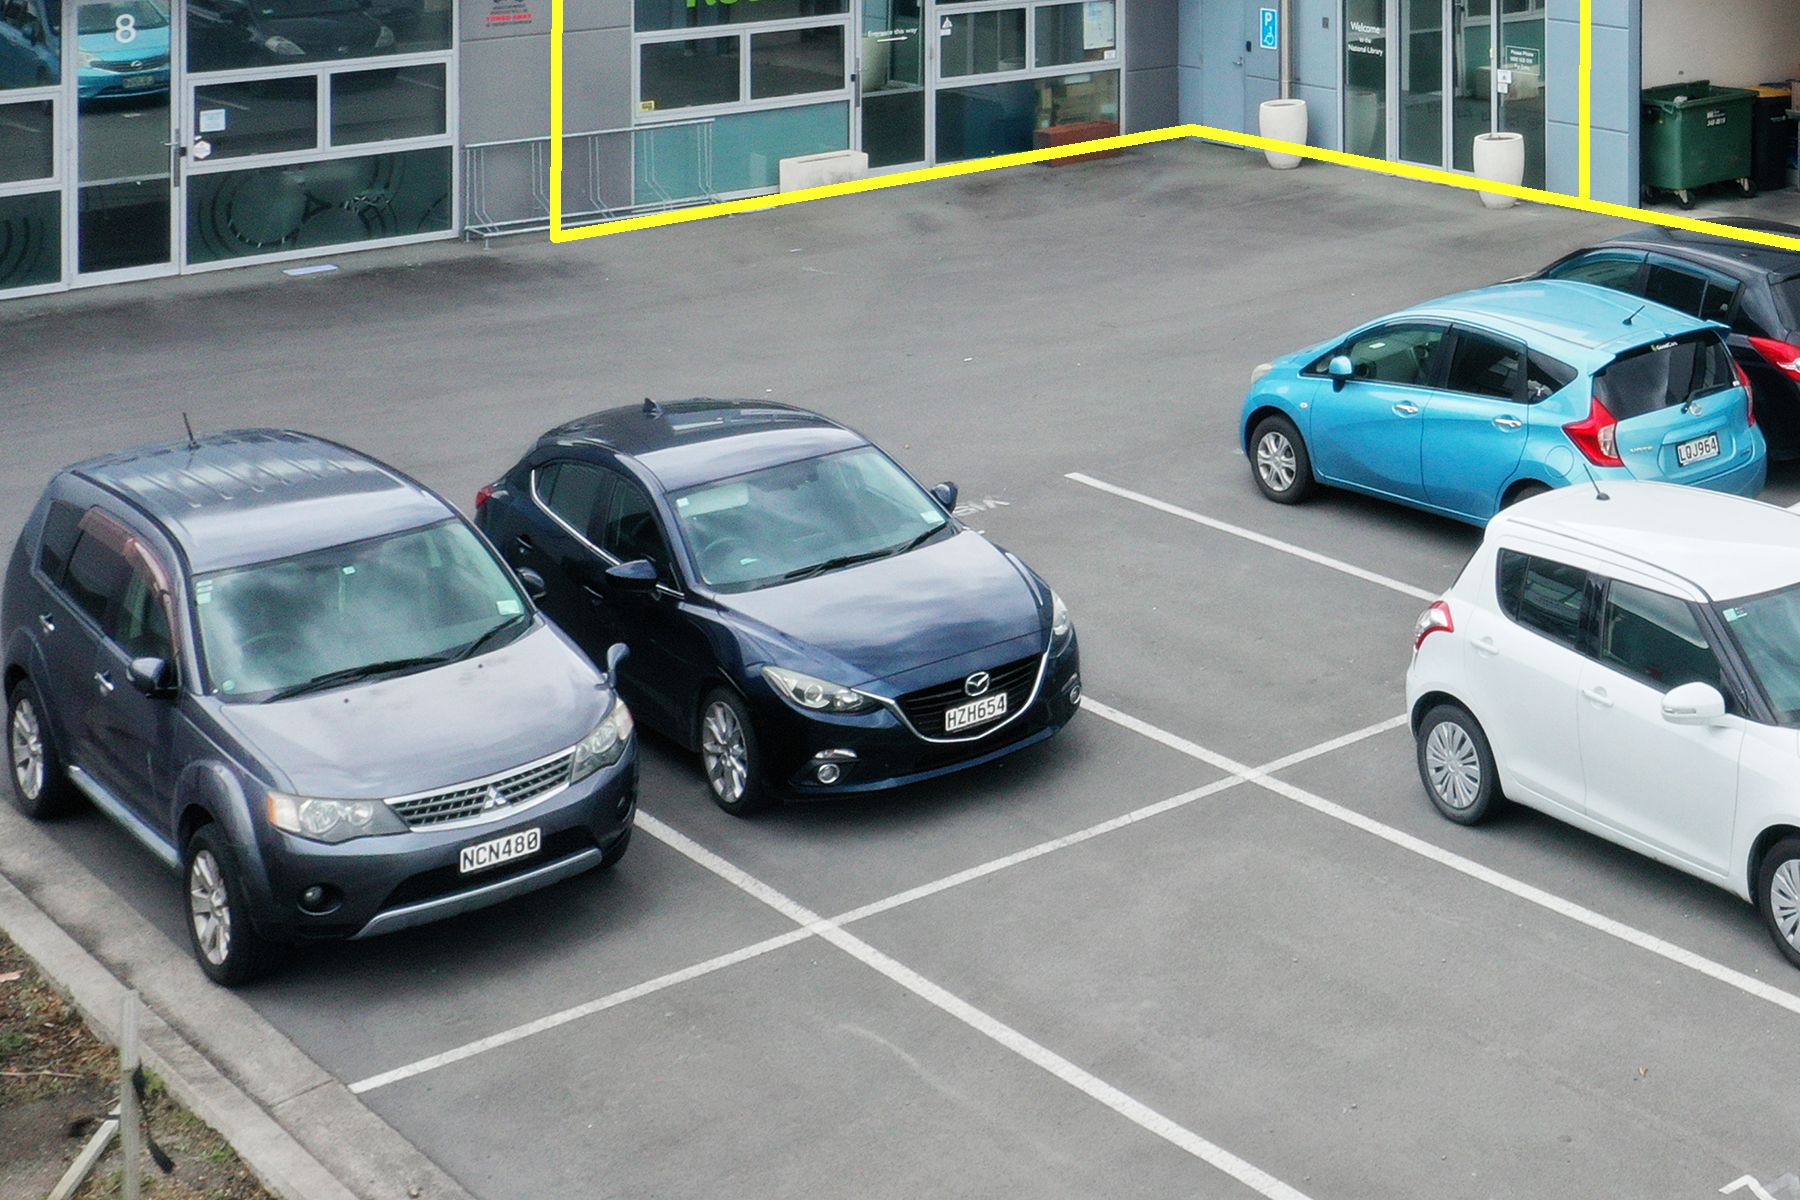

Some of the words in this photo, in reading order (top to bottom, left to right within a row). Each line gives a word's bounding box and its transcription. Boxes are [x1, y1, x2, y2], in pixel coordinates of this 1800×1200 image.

[115, 14, 136, 43] 8
[1265, 12, 1272, 26] P
[1350, 21, 1380, 34] Welcome
[1348, 44, 1366, 53] National
[1367, 45, 1383, 56] Library
[1679, 438, 1717, 461] LQJ964
[947, 696, 1005, 729] HZH654
[463, 831, 538, 870] NCN480
